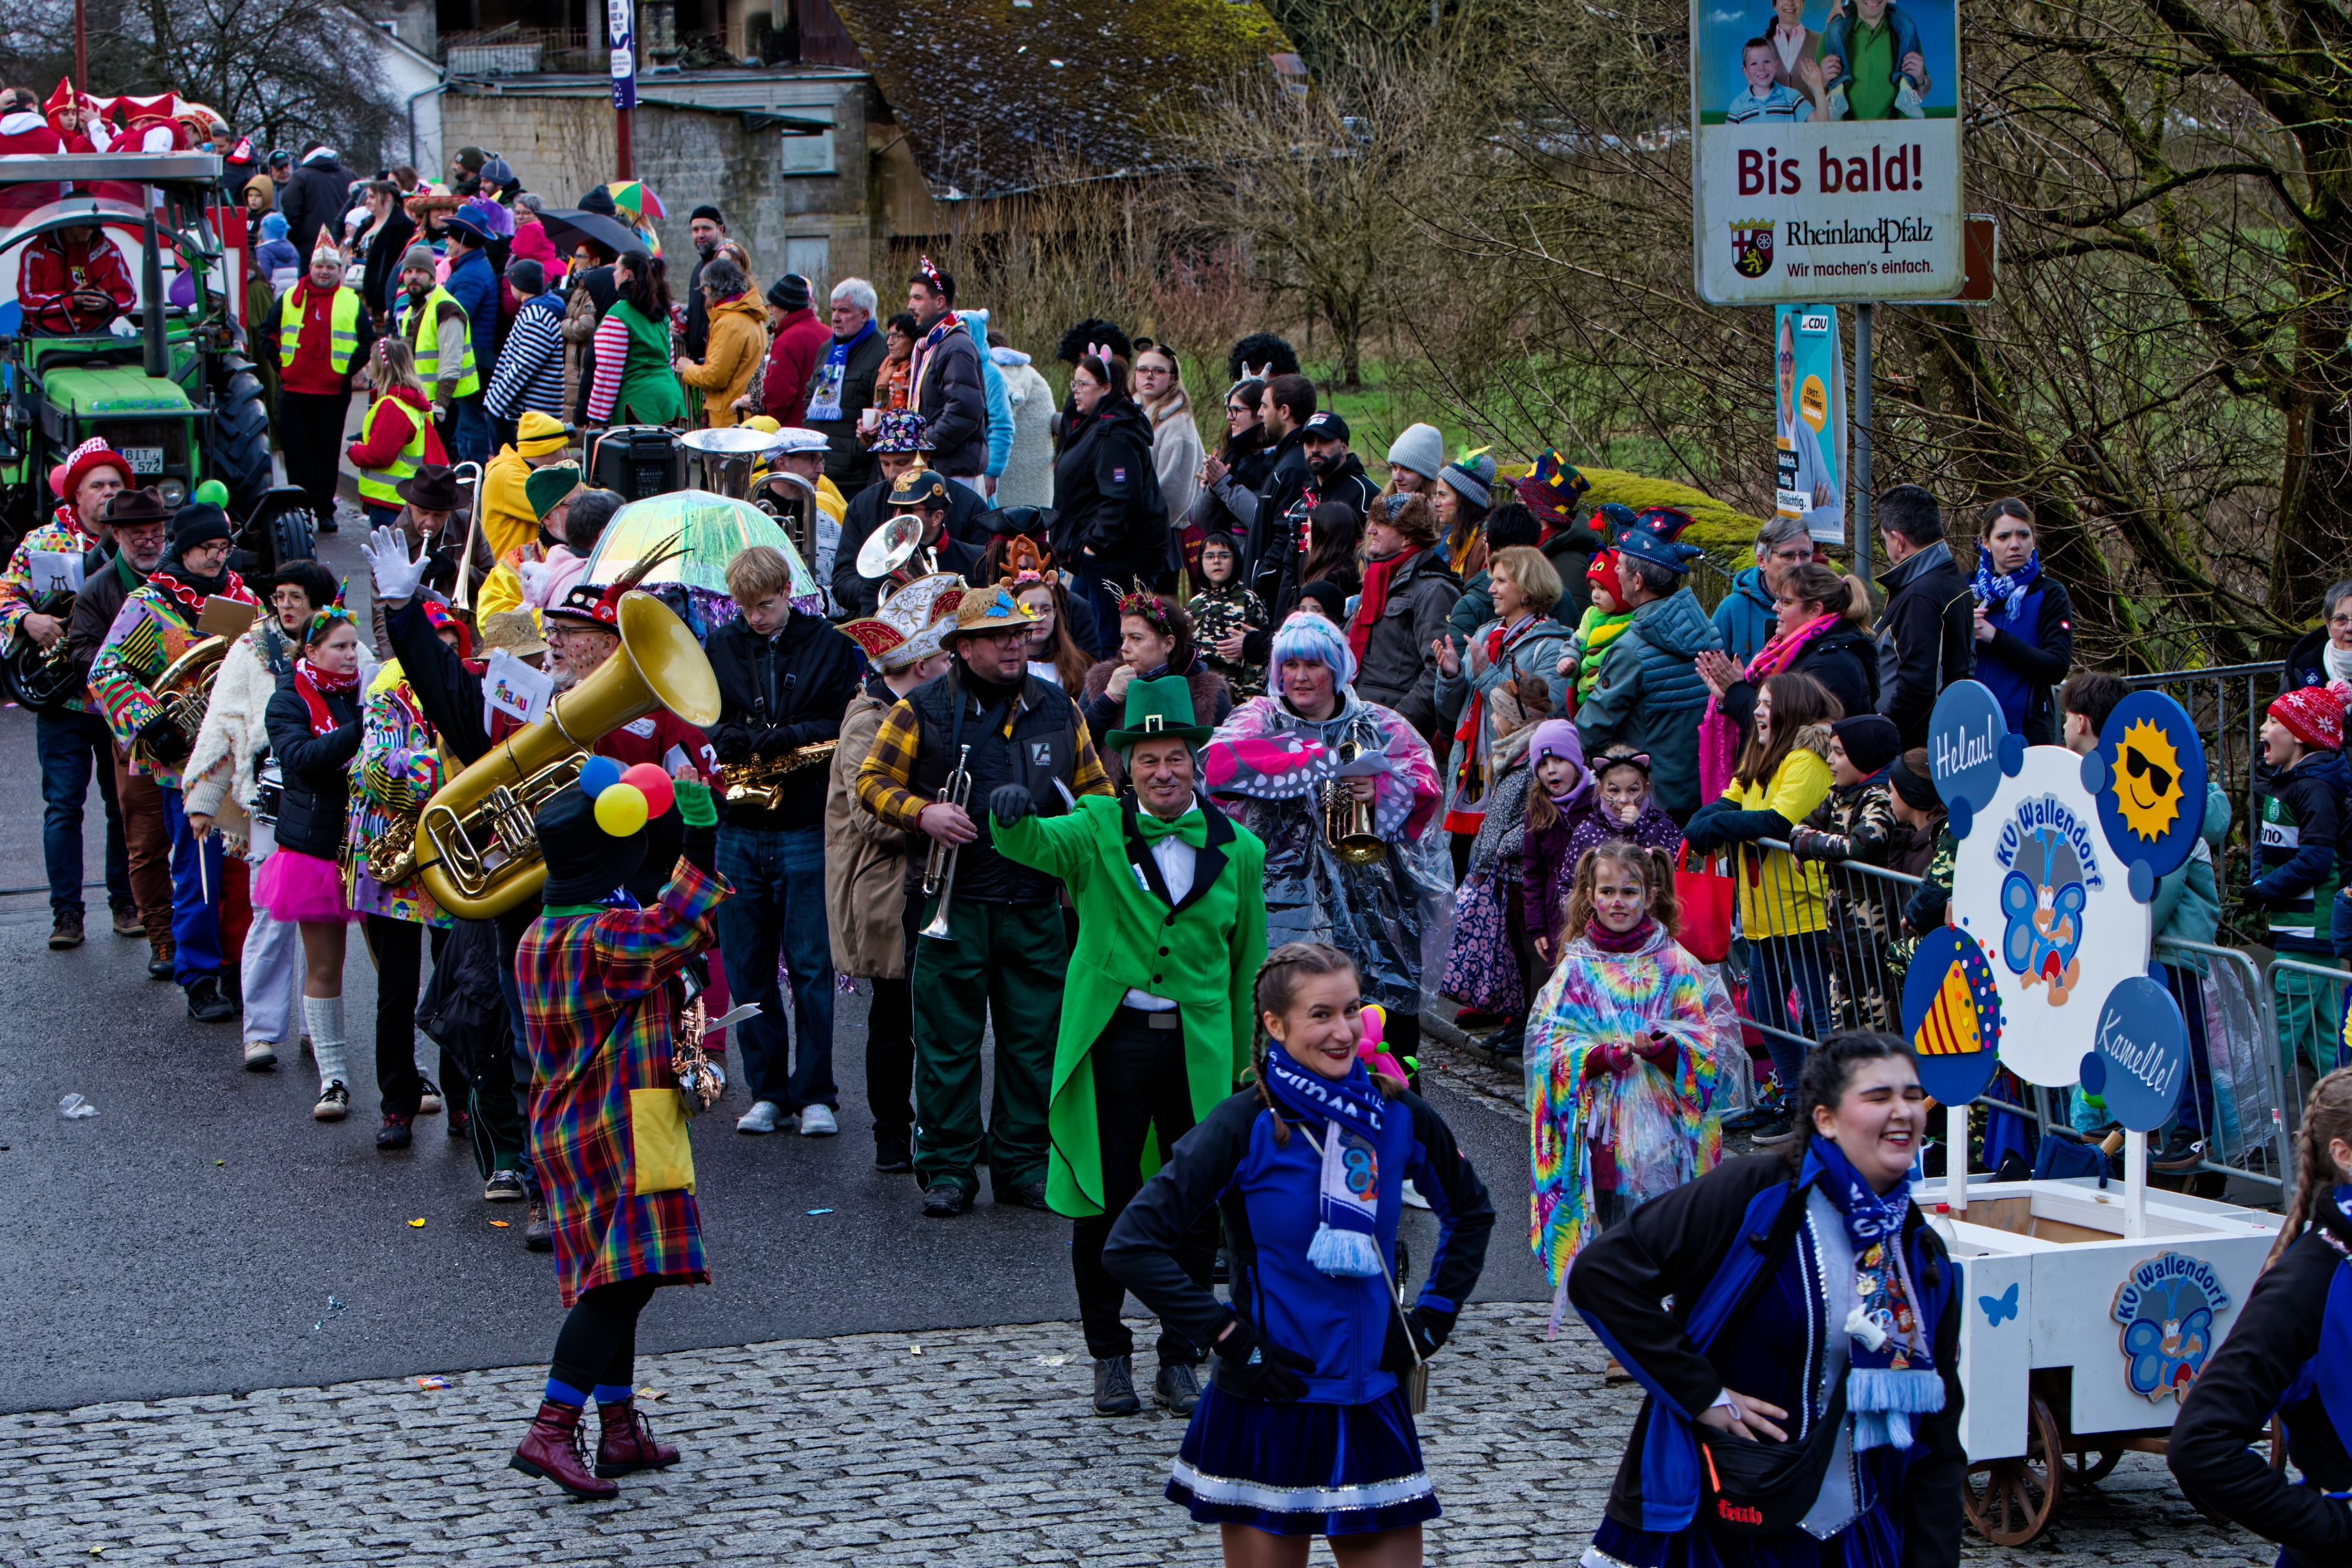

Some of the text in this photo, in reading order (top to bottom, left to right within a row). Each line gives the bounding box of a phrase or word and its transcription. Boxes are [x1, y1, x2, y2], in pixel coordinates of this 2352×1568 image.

[1738, 143, 1922, 195] Bis bald!
[1785, 217, 1934, 253] RheinlandPfalz
[1787, 259, 1934, 277] Wir machen's einfach.
[1809, 318, 1827, 329] CDU
[1807, 387, 1820, 399] ERST-
[1804, 396, 1822, 410] STIMME
[1803, 405, 1822, 420] LUDWIG
[126, 450, 150, 460] BIT
[1778, 453, 1797, 468] Natürlich.
[138, 461, 160, 472] 572
[1778, 471, 1793, 489] Tüchtig.
[1936, 714, 1993, 780] Helau!
[2018, 798, 2101, 886] Wallendorf
[2097, 1008, 2178, 1097] Kamelle!
[2137, 1256, 2228, 1306] Wallendorf
